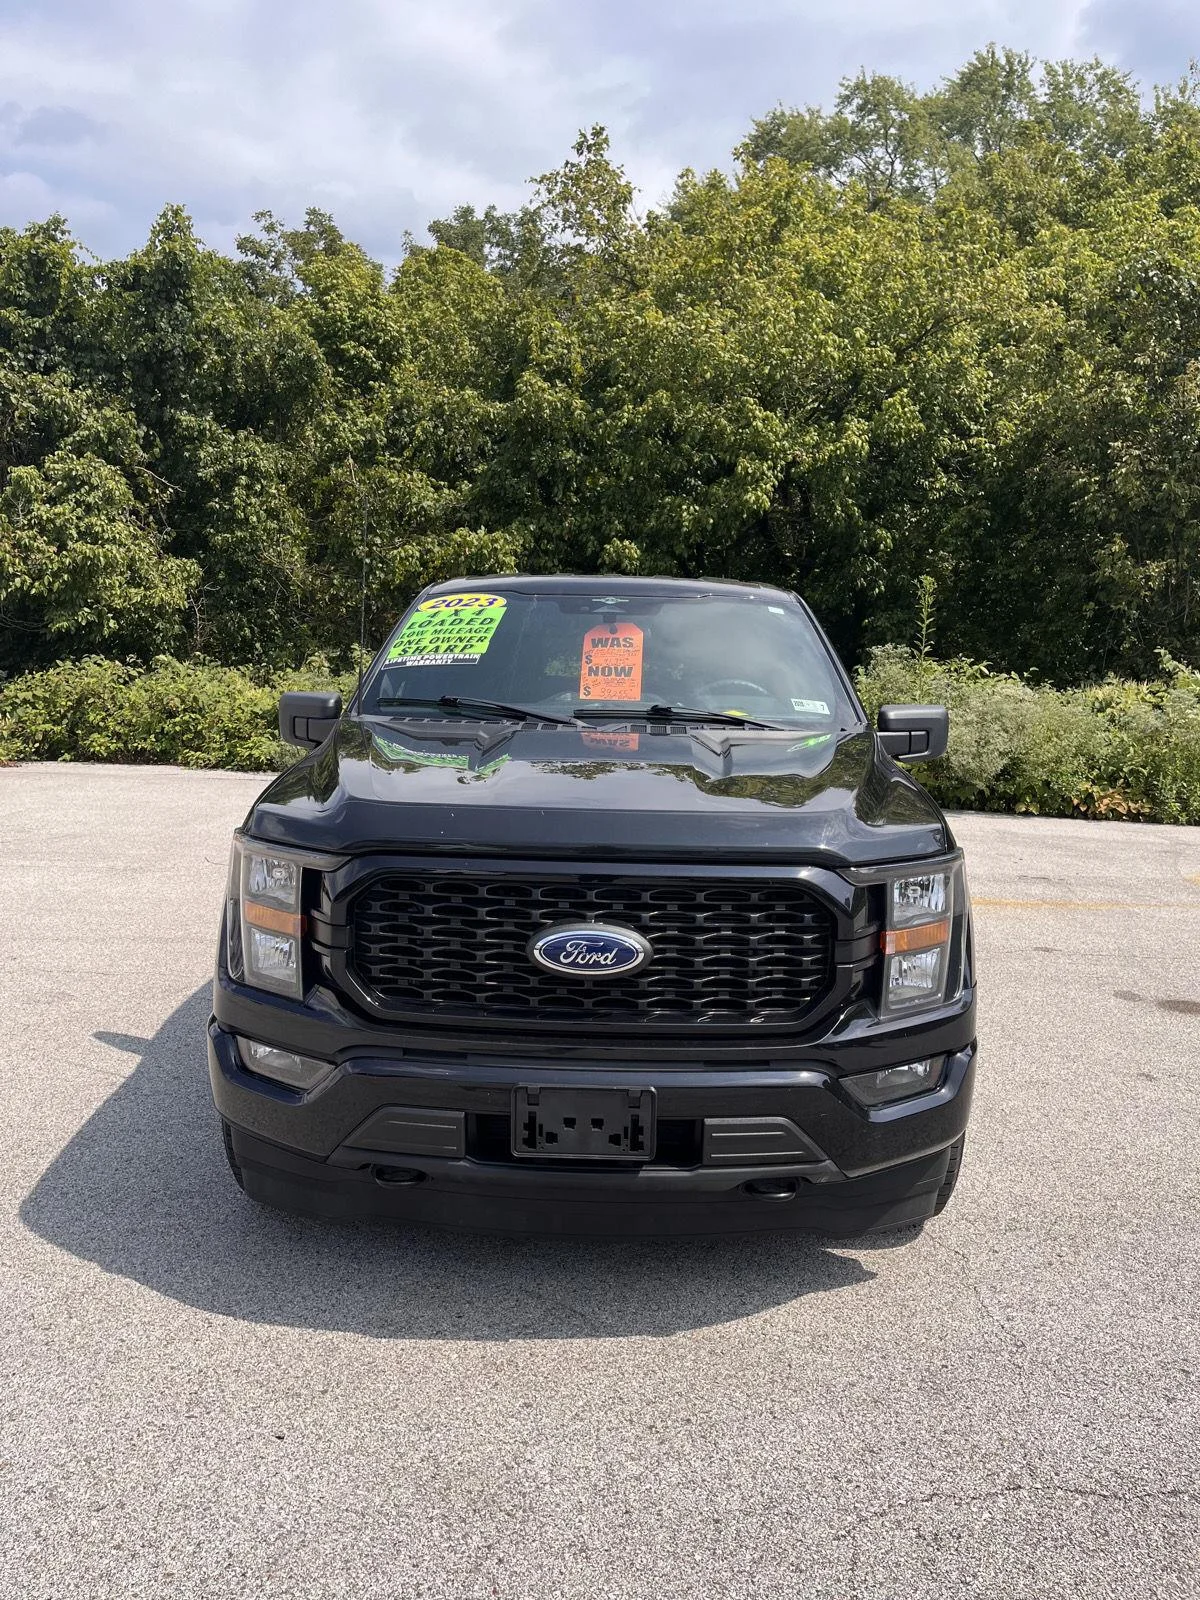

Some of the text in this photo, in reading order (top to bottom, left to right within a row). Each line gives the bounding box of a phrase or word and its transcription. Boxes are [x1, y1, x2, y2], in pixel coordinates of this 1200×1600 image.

[426, 598, 498, 609] 2023
[426, 610, 443, 619] 4
[471, 608, 486, 616] 4
[406, 617, 496, 630] LOADED
[399, 627, 494, 639] LOW MILEAGE
[392, 636, 488, 649] ONE OWNER
[591, 637, 633, 648] WAS
[397, 644, 475, 656] SHARP
[385, 655, 422, 665] LIFETIME
[584, 654, 593, 665] $
[587, 666, 633, 678] NOW
[583, 685, 592, 697] $
[560, 940, 618, 965] Ford
